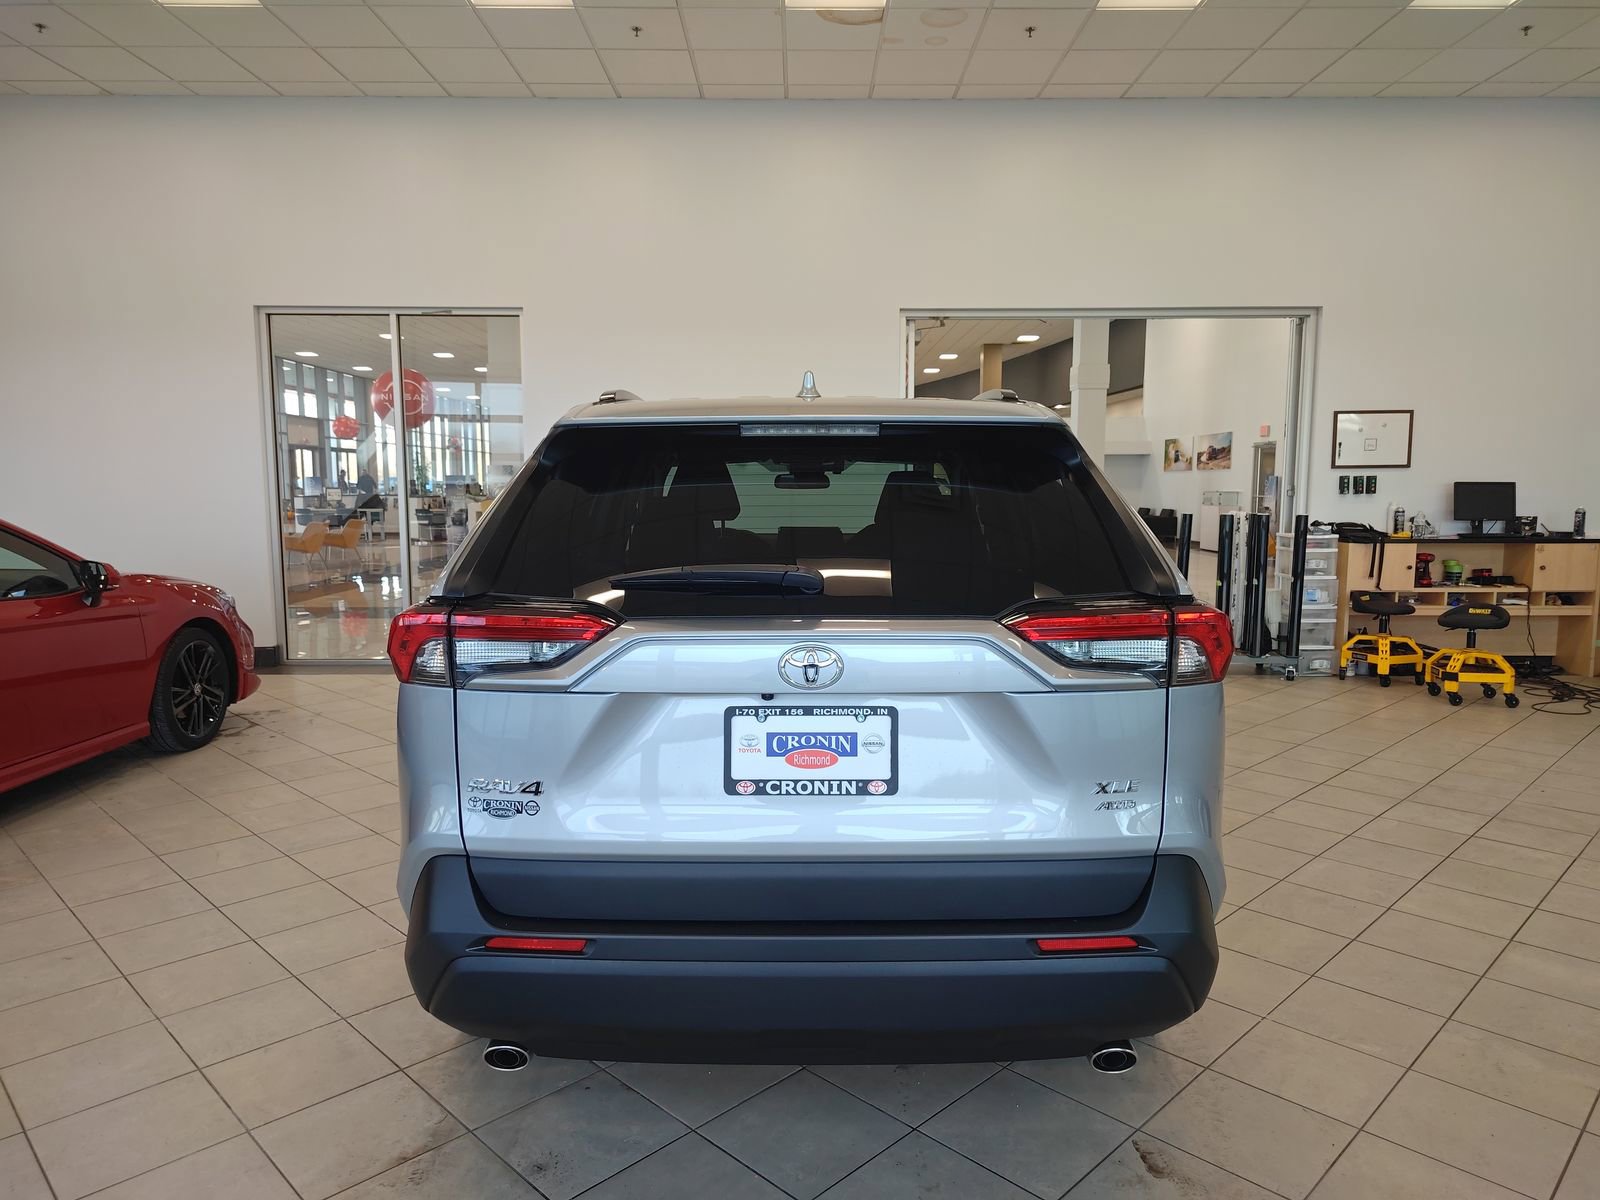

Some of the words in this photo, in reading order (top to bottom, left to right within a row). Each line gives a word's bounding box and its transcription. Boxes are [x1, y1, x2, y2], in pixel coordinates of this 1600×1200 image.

[381, 393, 429, 401] NISAN
[735, 708, 755, 716] I-70
[758, 708, 781, 716] EXIT
[784, 708, 804, 716] 156
[877, 708, 888, 716] IN
[772, 734, 852, 753] CRONIN
[793, 754, 831, 766] Richmond
[467, 778, 544, 796] RAV4
[766, 780, 857, 795] CRONIN
[1092, 780, 1140, 795] XLE
[483, 800, 522, 812] CRONIN
